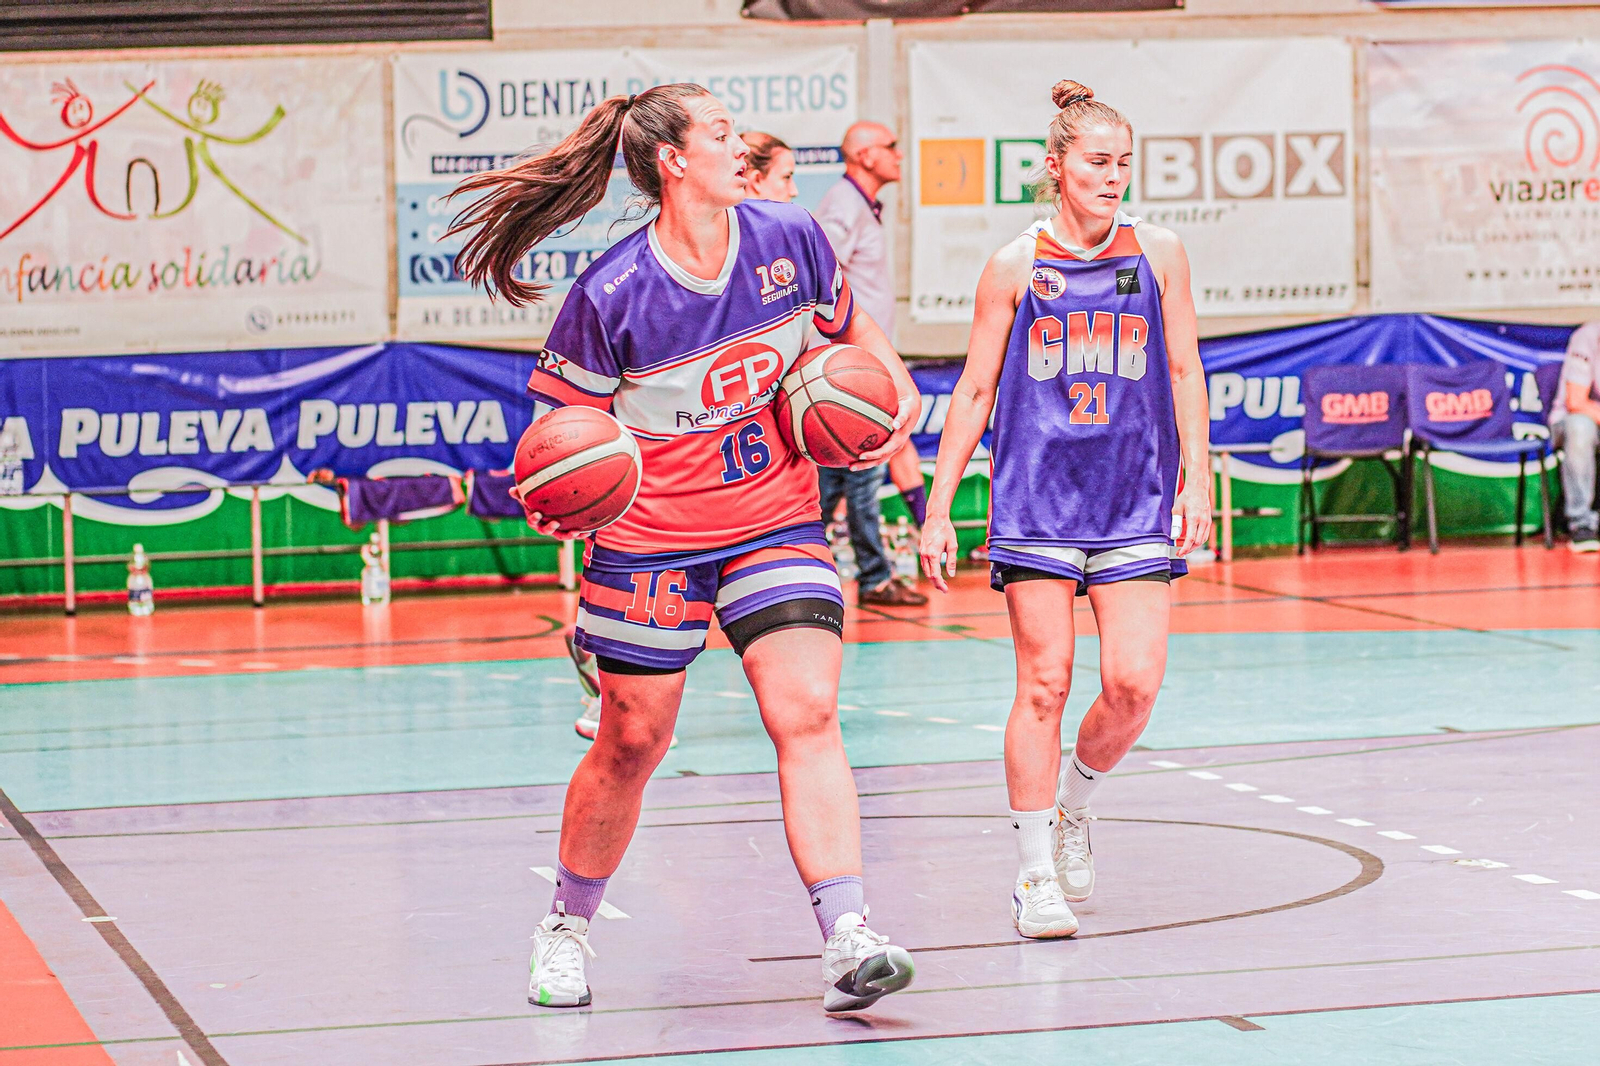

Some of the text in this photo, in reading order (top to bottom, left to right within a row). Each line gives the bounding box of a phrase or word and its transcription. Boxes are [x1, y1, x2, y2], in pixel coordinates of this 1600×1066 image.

[626, 74, 848, 112] ESTEROS
[1000, 134, 1345, 202] PBOX
[1147, 208, 1224, 225] center
[519, 251, 566, 279] 120
[612, 262, 639, 287] Cervi
[1027, 310, 1149, 382] GMB
[709, 350, 779, 403] FP
[675, 402, 745, 429] Reina
[1068, 382, 1110, 425] 21
[1321, 391, 1389, 416] GMB
[1425, 388, 1493, 415] GMB
[58, 407, 275, 458] PULEVA
[296, 399, 510, 450] PULEVA
[719, 420, 772, 485] 16
[623, 568, 688, 629] 16
